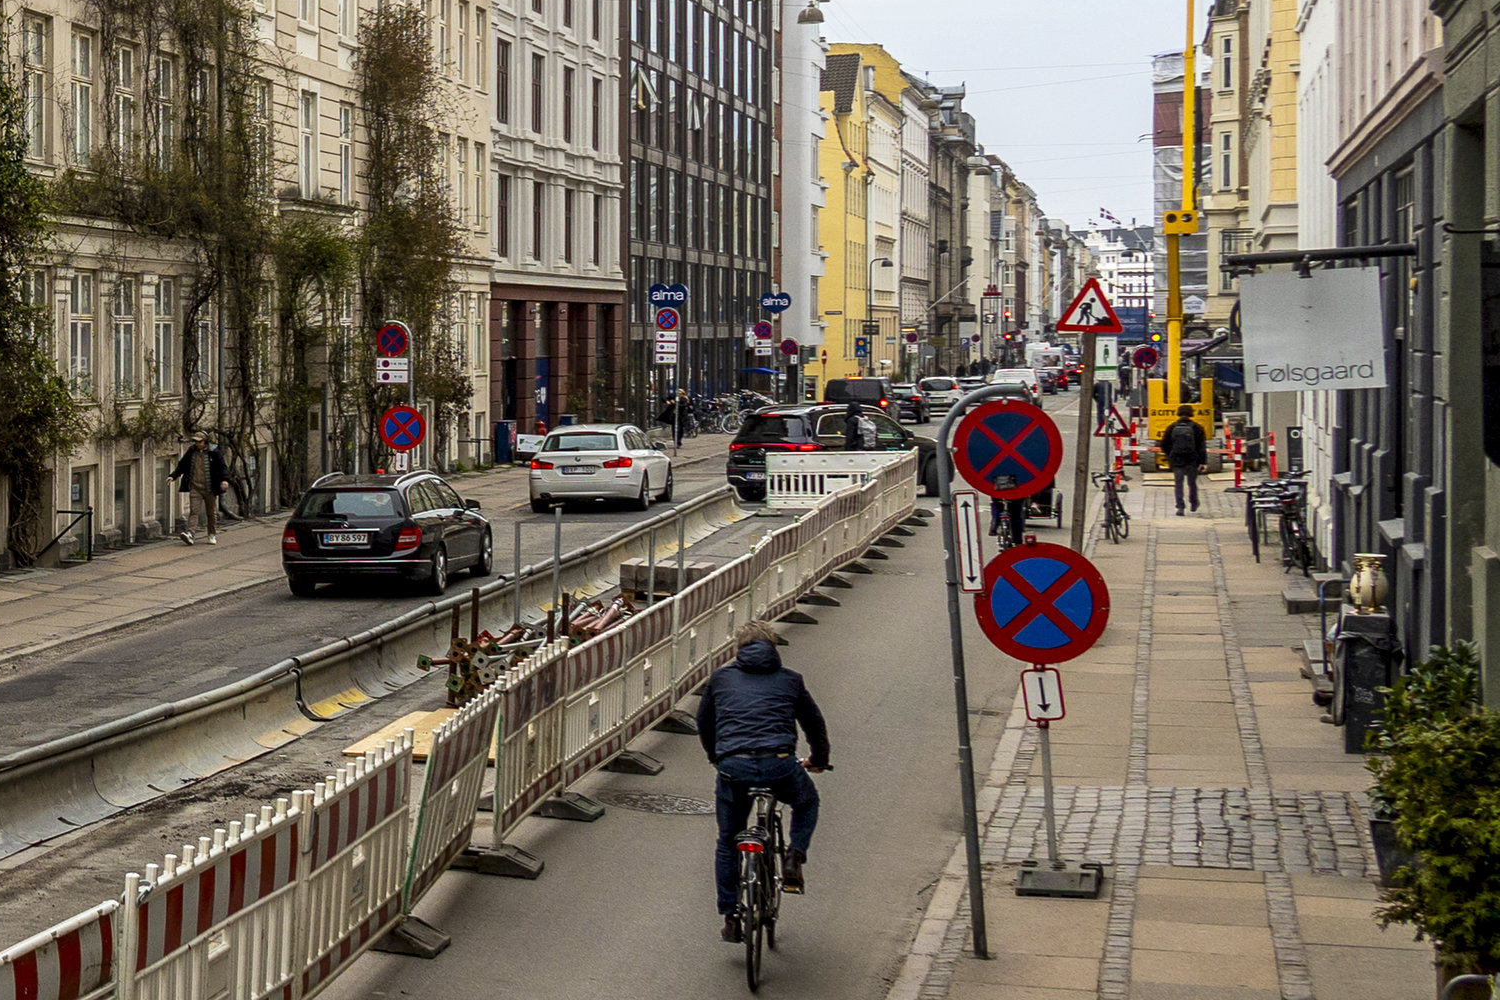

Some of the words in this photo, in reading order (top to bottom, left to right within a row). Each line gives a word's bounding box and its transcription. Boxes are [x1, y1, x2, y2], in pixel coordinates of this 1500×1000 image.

[651, 290, 685, 301] alma
[762, 296, 789, 306] alma
[1255, 360, 1374, 386] Følsgaard
[352, 534, 367, 542] 597
